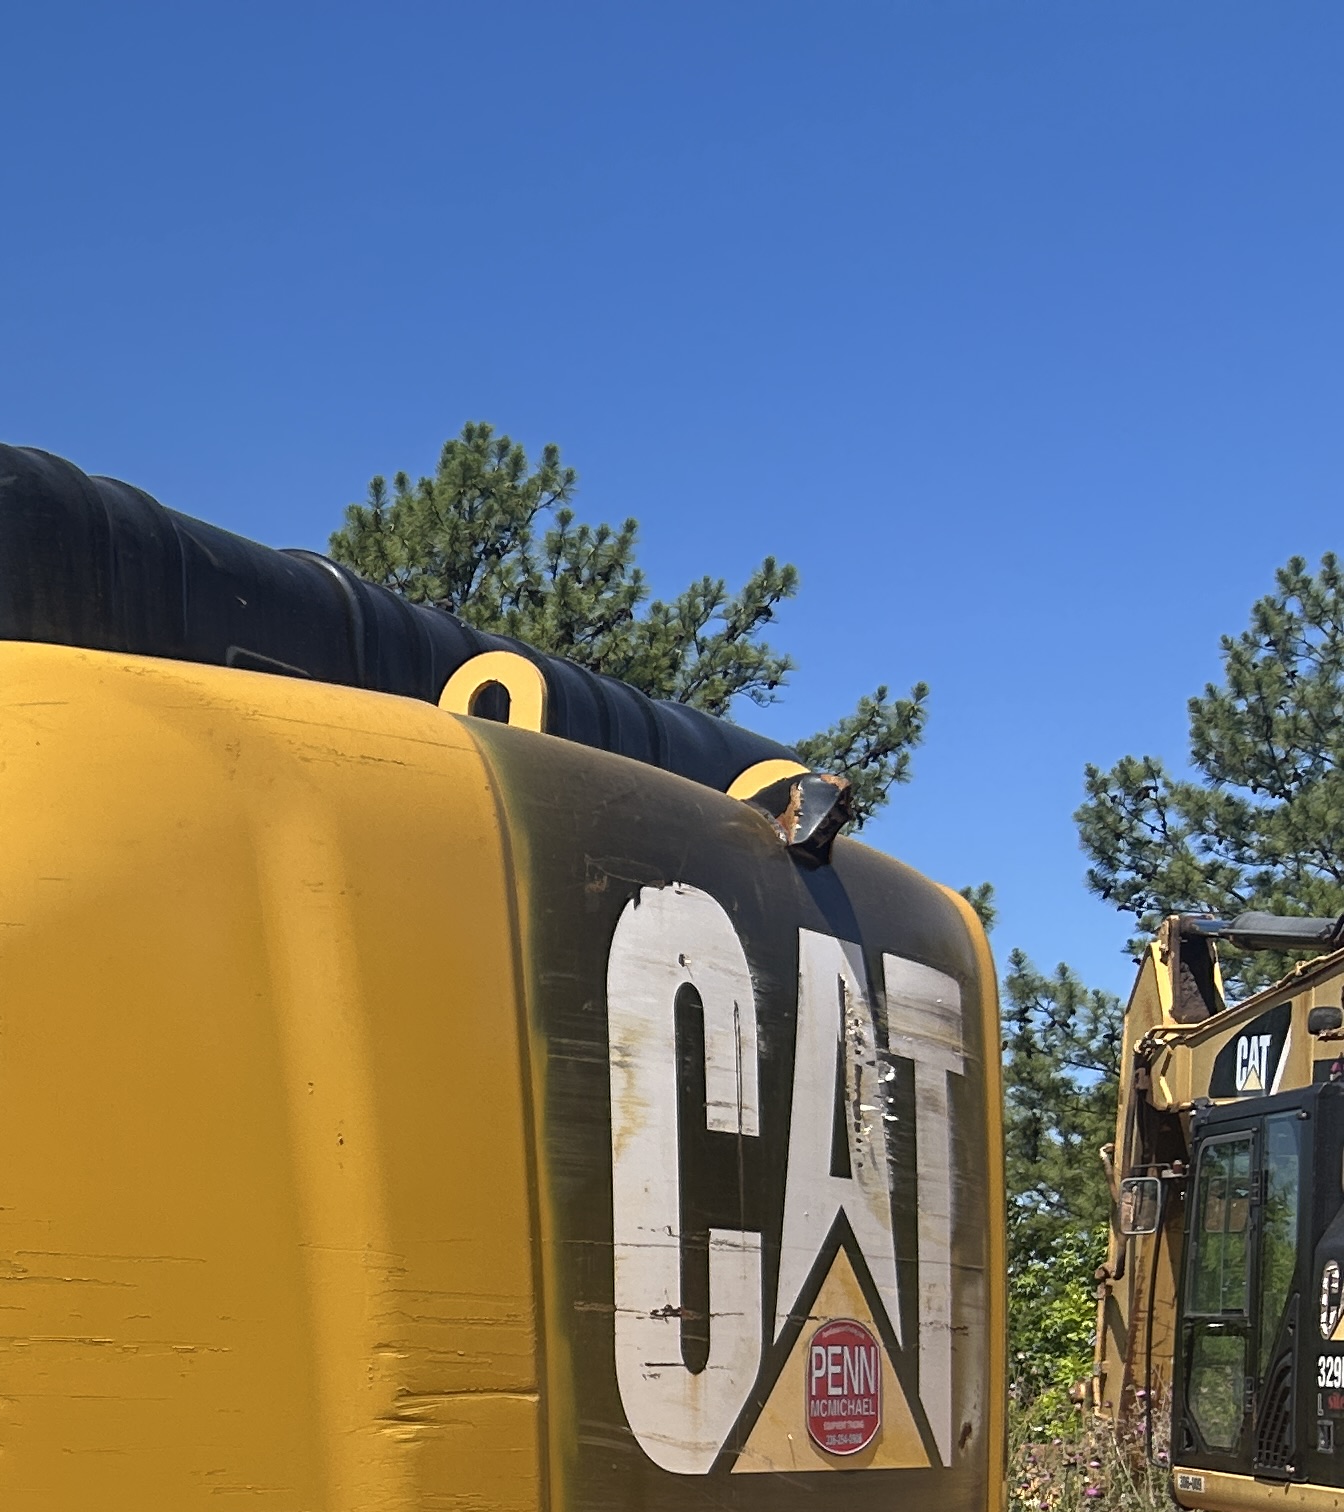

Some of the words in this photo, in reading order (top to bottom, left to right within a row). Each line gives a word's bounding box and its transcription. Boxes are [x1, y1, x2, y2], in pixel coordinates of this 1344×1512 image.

[1236, 1034, 1272, 1091] CAT
[607, 881, 964, 1475] CAT
[1320, 1259, 1344, 1340] C
[811, 1345, 876, 1396] PENN
[1317, 1356, 1344, 1388] 329
[811, 1398, 876, 1417] MCMICHAEL
